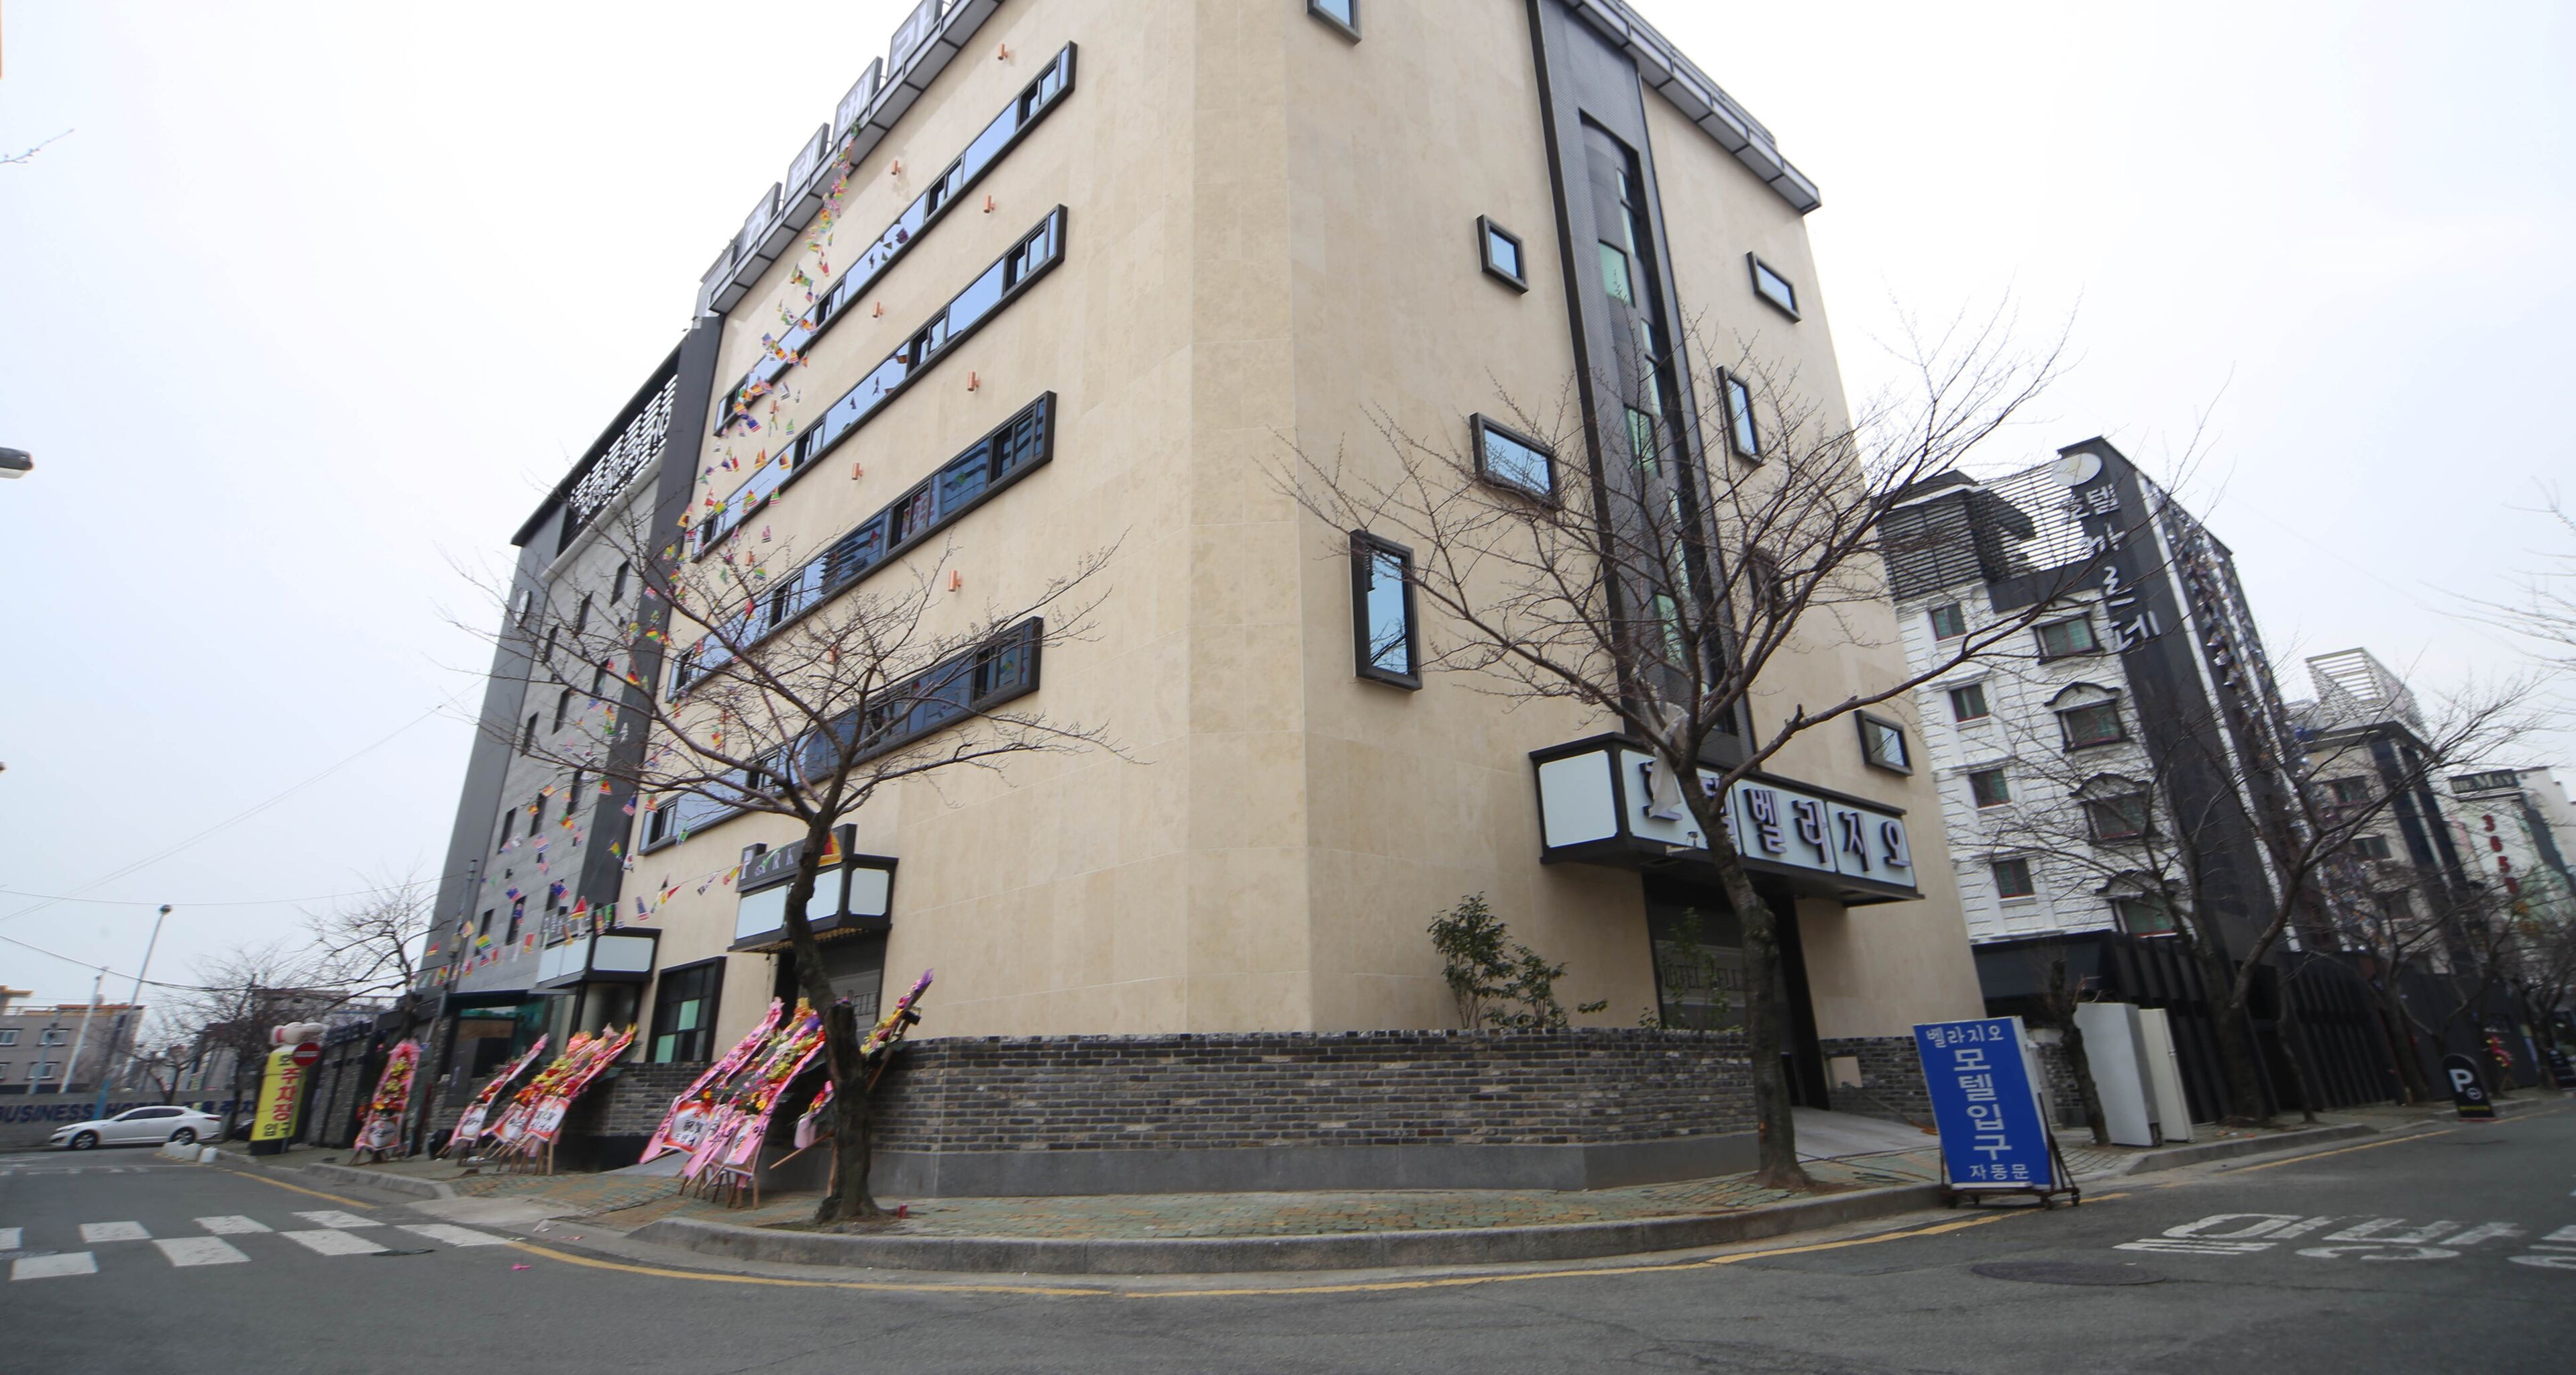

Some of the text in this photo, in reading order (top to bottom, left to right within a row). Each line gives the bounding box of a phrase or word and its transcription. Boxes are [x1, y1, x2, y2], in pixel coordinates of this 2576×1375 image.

[1925, 1025, 2004, 1048] 벨라지오
[2449, 1069, 2474, 1092] P
[273, 1068, 301, 1121] 주차장
[1953, 1048, 2012, 1160] 모텔입구
[1970, 1164, 2029, 1180] 자동문
